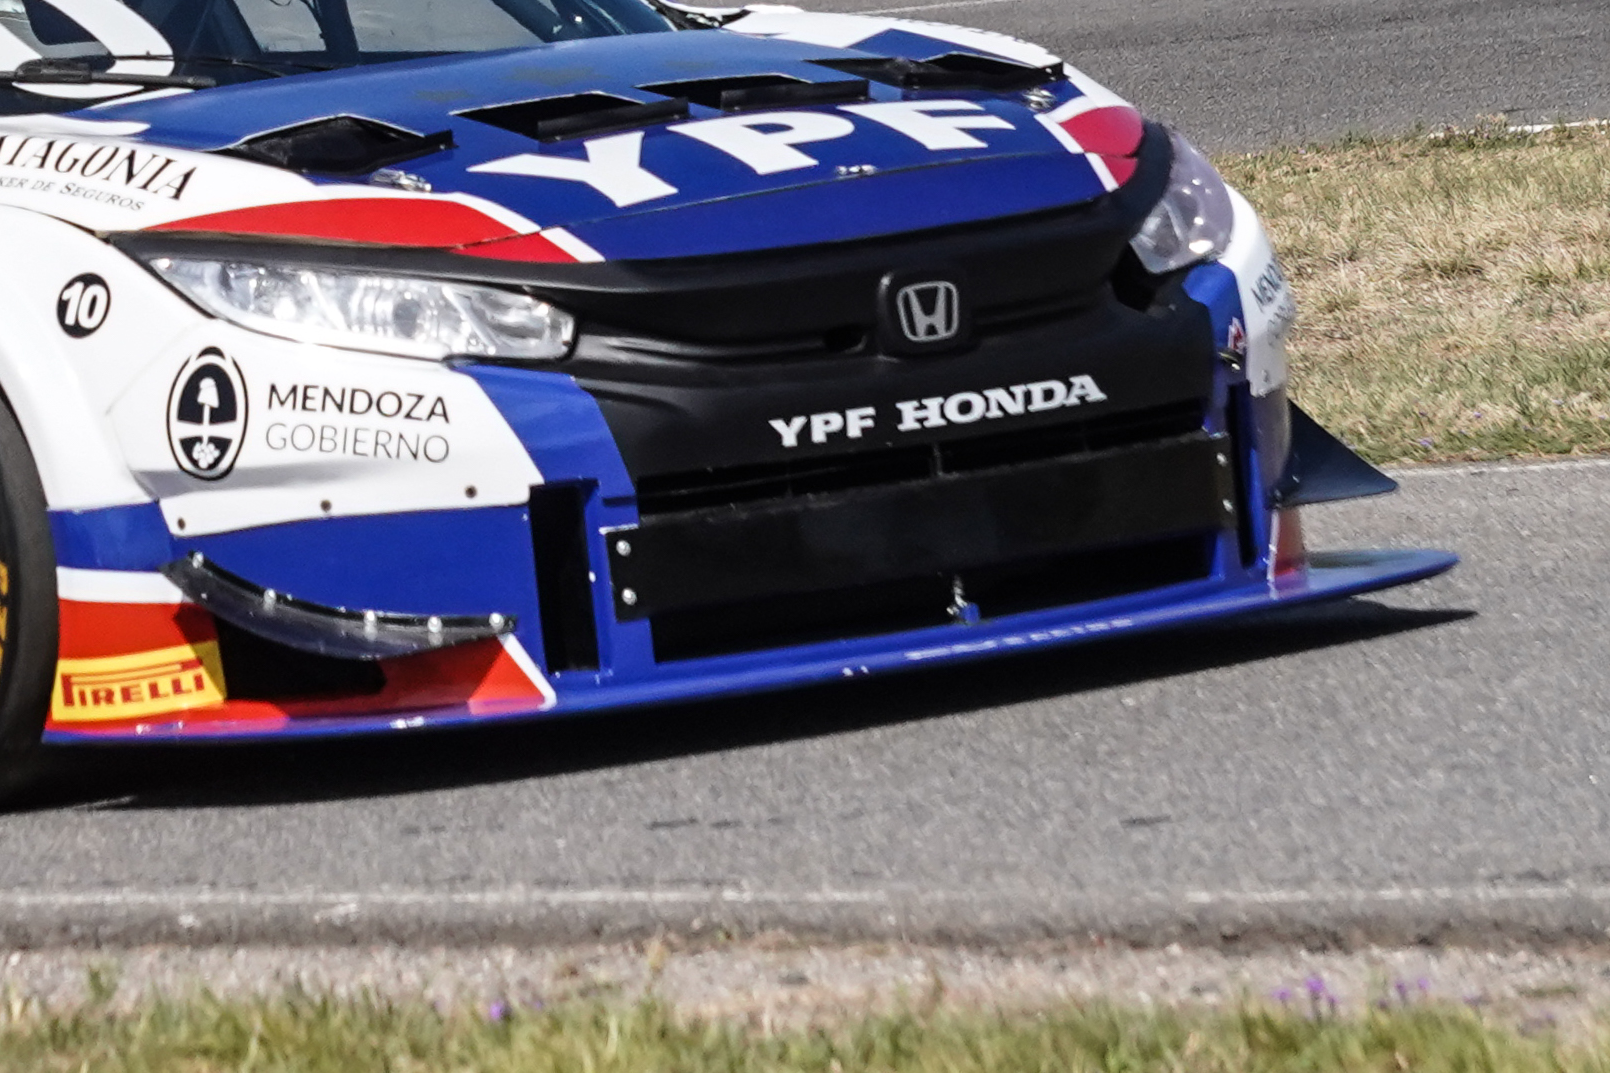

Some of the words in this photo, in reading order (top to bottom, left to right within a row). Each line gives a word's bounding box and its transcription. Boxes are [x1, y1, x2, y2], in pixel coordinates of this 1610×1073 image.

[466, 100, 1016, 208] YPF
[32, 179, 56, 192] DE
[59, 182, 145, 213] SEGUROS
[61, 281, 108, 326] 10
[267, 383, 450, 424] MENDOZA
[768, 406, 877, 447] YPF
[895, 374, 1108, 431] HONDA
[265, 421, 450, 464] GOBIERNO
[60, 659, 205, 707] PIRELLI
